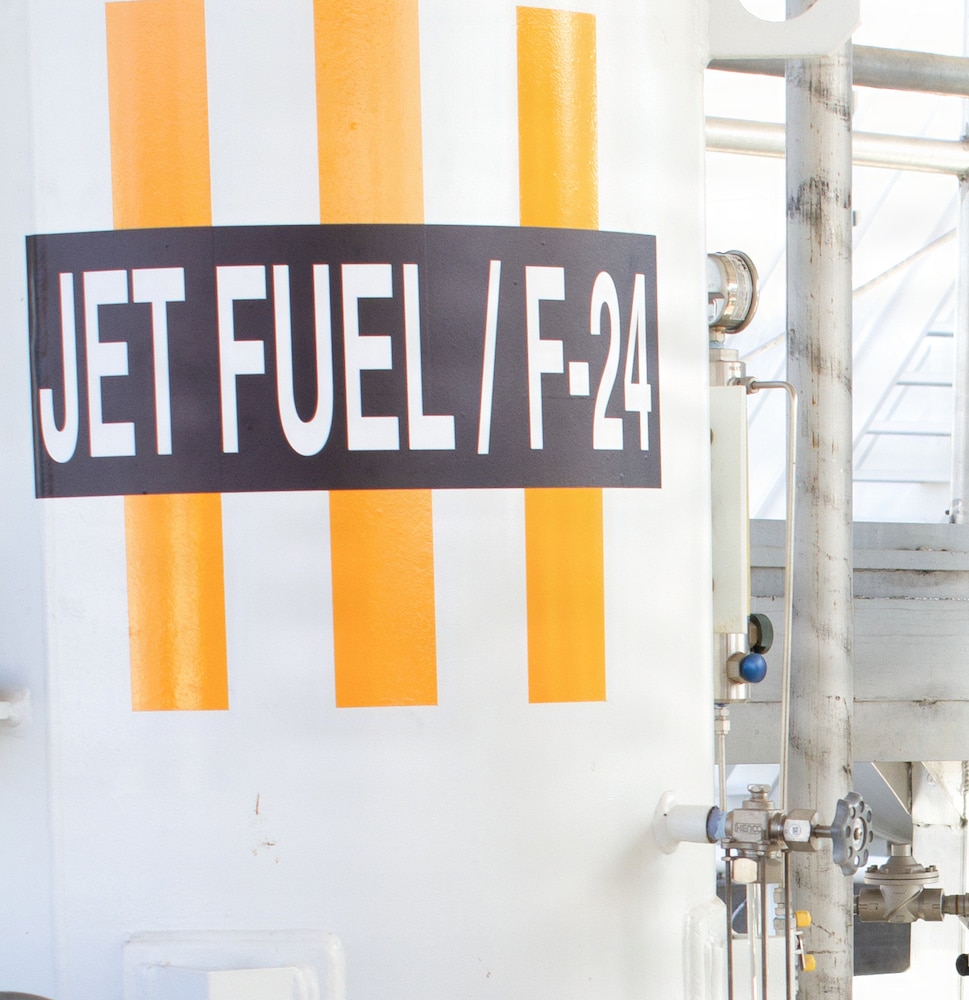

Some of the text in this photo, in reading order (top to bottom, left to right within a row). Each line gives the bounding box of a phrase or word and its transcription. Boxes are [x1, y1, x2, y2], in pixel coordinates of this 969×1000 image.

[39, 260, 652, 464] JET FUEL / F-24
